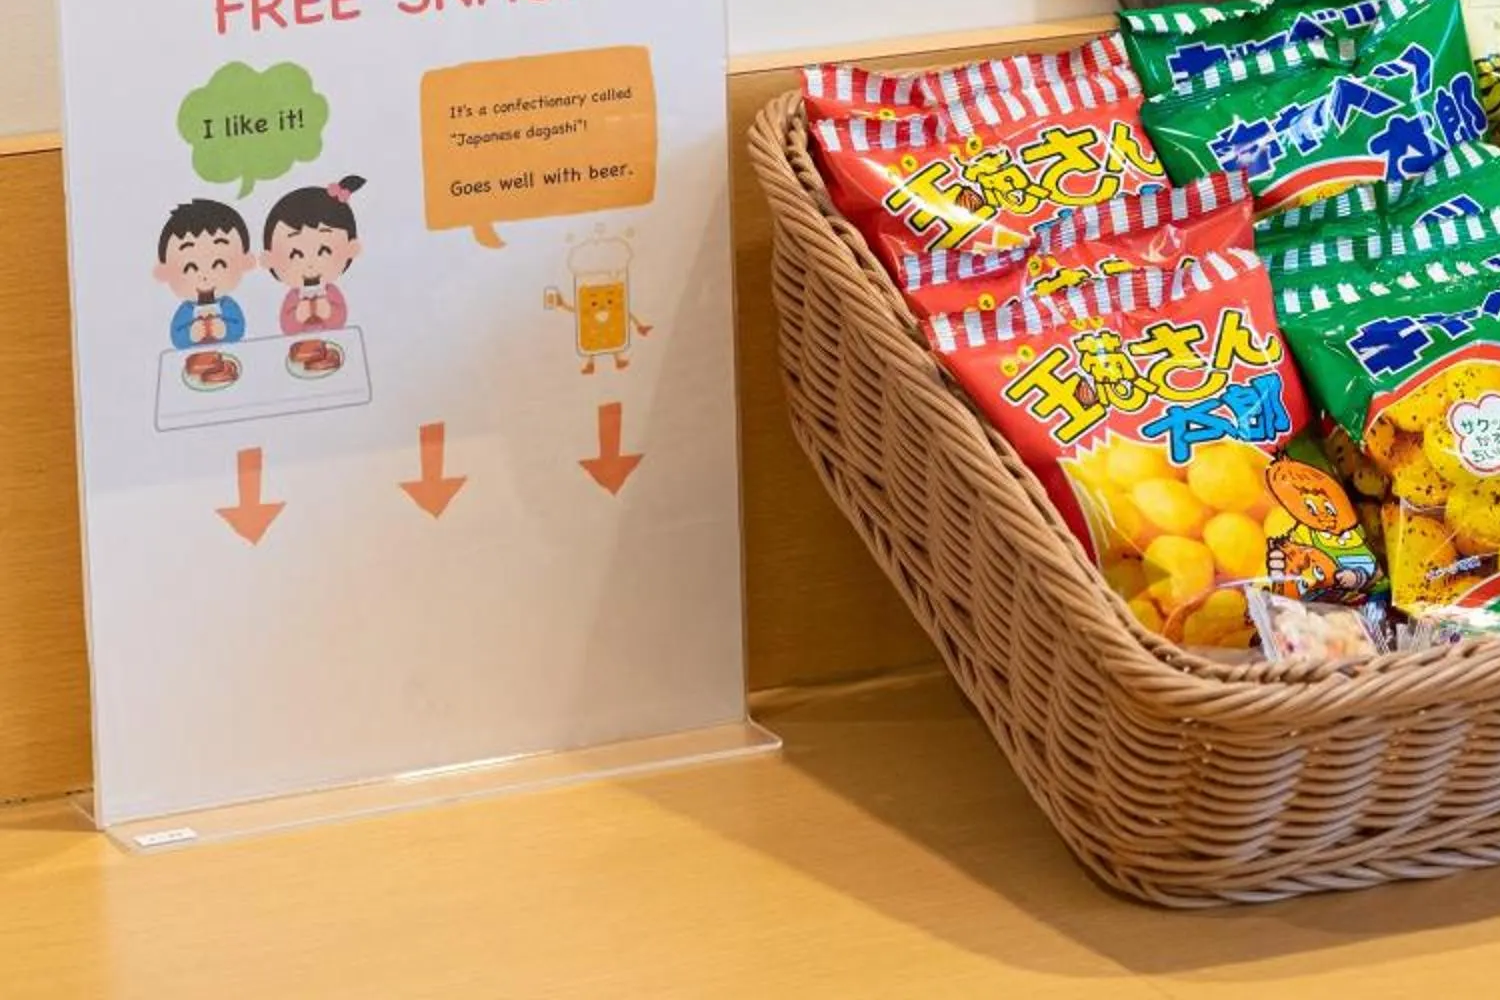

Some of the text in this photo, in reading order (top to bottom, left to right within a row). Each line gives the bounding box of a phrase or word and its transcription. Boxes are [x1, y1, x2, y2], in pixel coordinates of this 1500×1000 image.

[449, 86, 633, 119] It's a confectionary called
[203, 108, 305, 139] I like it!
[450, 162, 635, 197] Goes well with beer.
